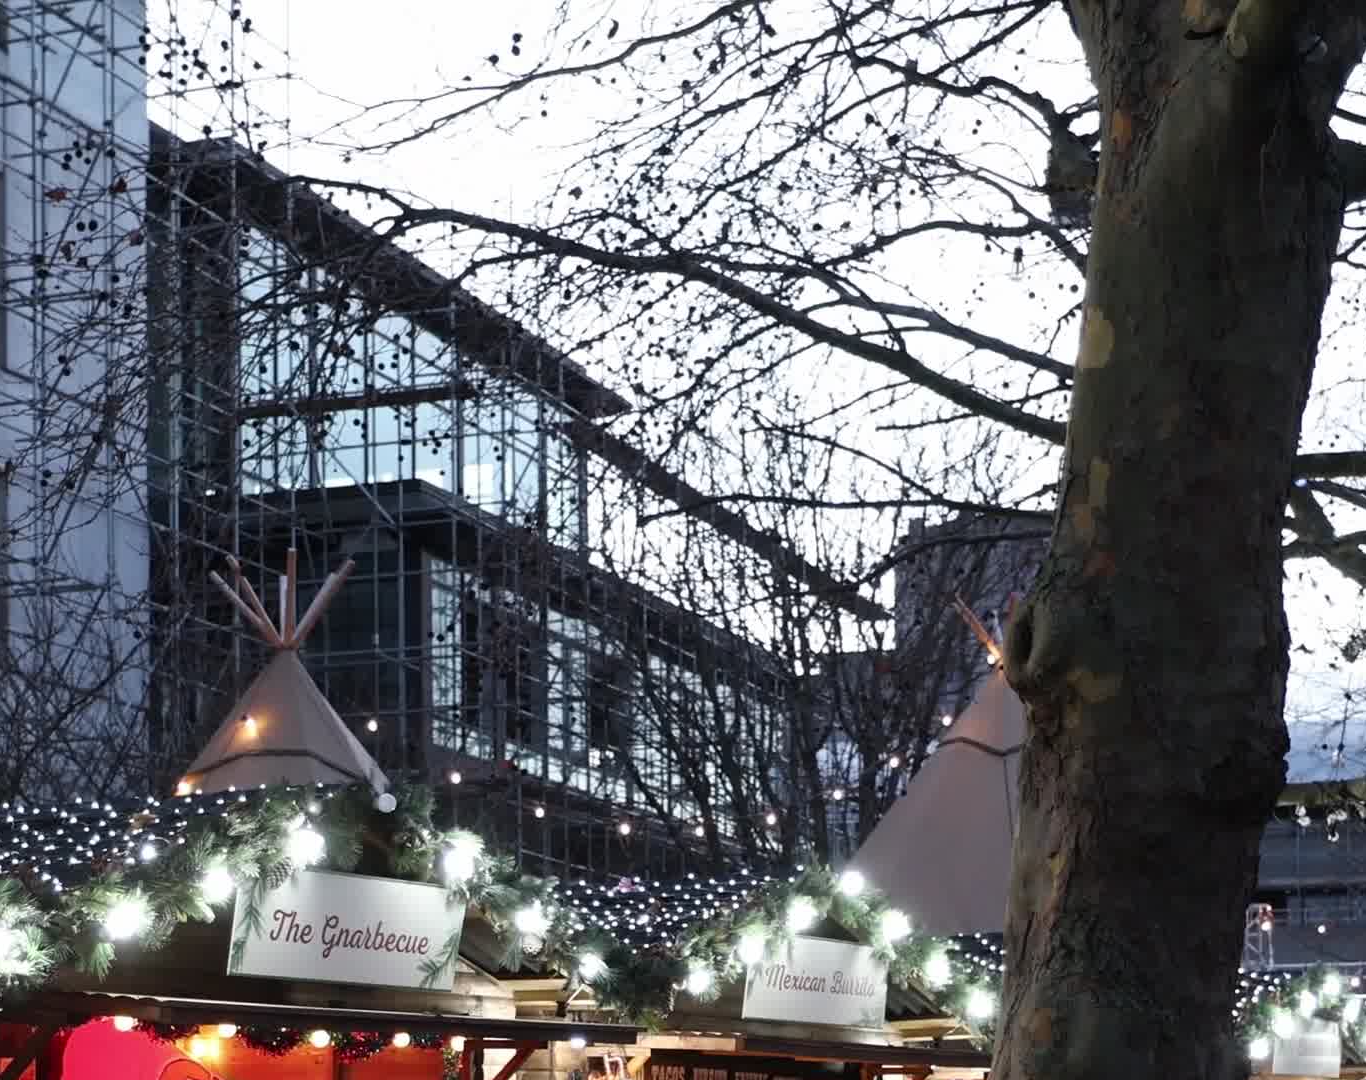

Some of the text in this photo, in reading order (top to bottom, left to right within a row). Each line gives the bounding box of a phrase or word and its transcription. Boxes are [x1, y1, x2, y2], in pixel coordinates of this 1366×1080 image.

[270, 909, 428, 958] The Gnarbecue
[765, 963, 826, 993] Mexican
